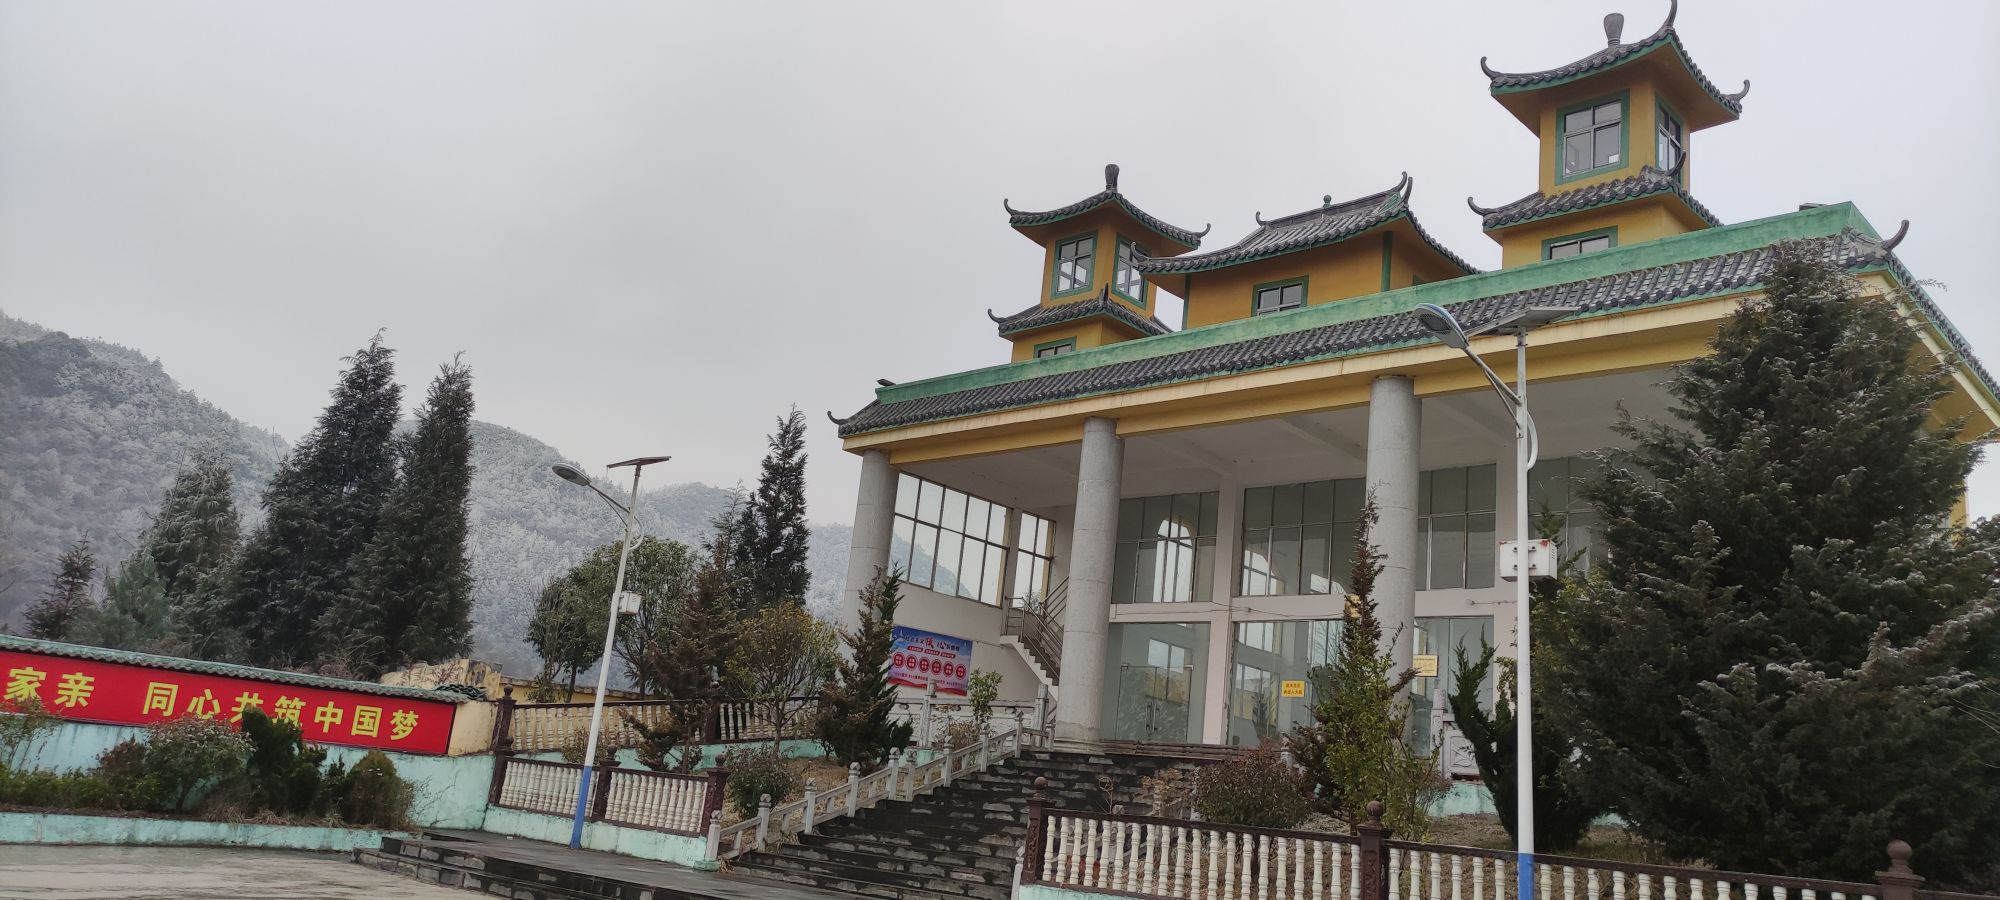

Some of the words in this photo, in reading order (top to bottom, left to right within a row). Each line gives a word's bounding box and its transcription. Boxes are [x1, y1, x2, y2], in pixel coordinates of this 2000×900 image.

[3, 666, 95, 708] 家亲
[142, 681, 419, 741] 同心共筑中国梦
